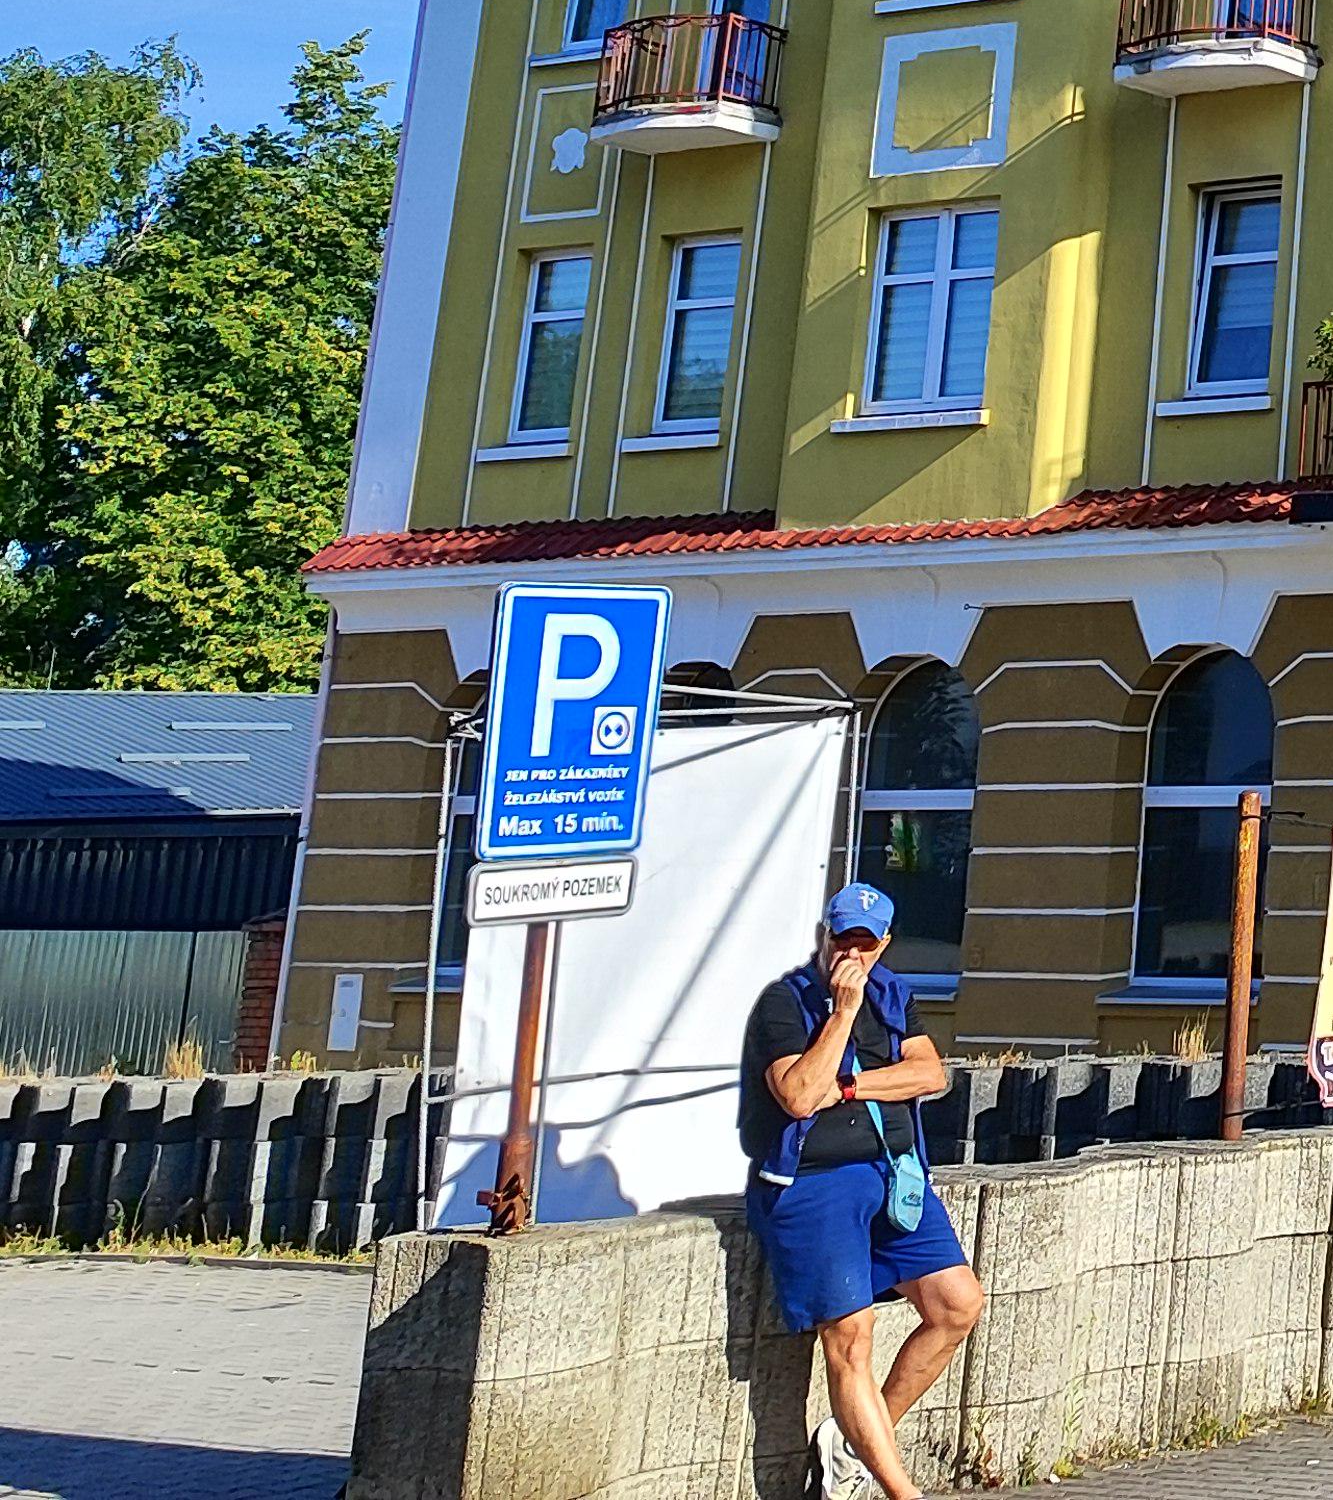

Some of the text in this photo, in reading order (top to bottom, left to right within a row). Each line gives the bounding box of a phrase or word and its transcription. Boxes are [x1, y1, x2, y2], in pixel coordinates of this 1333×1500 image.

[530, 612, 621, 758] P
[504, 769, 528, 782] JEN
[530, 768, 556, 781] PRO
[498, 815, 543, 837] Max
[553, 813, 579, 834] 15
[484, 875, 623, 905] SOUKROMÝ POZEMEK
